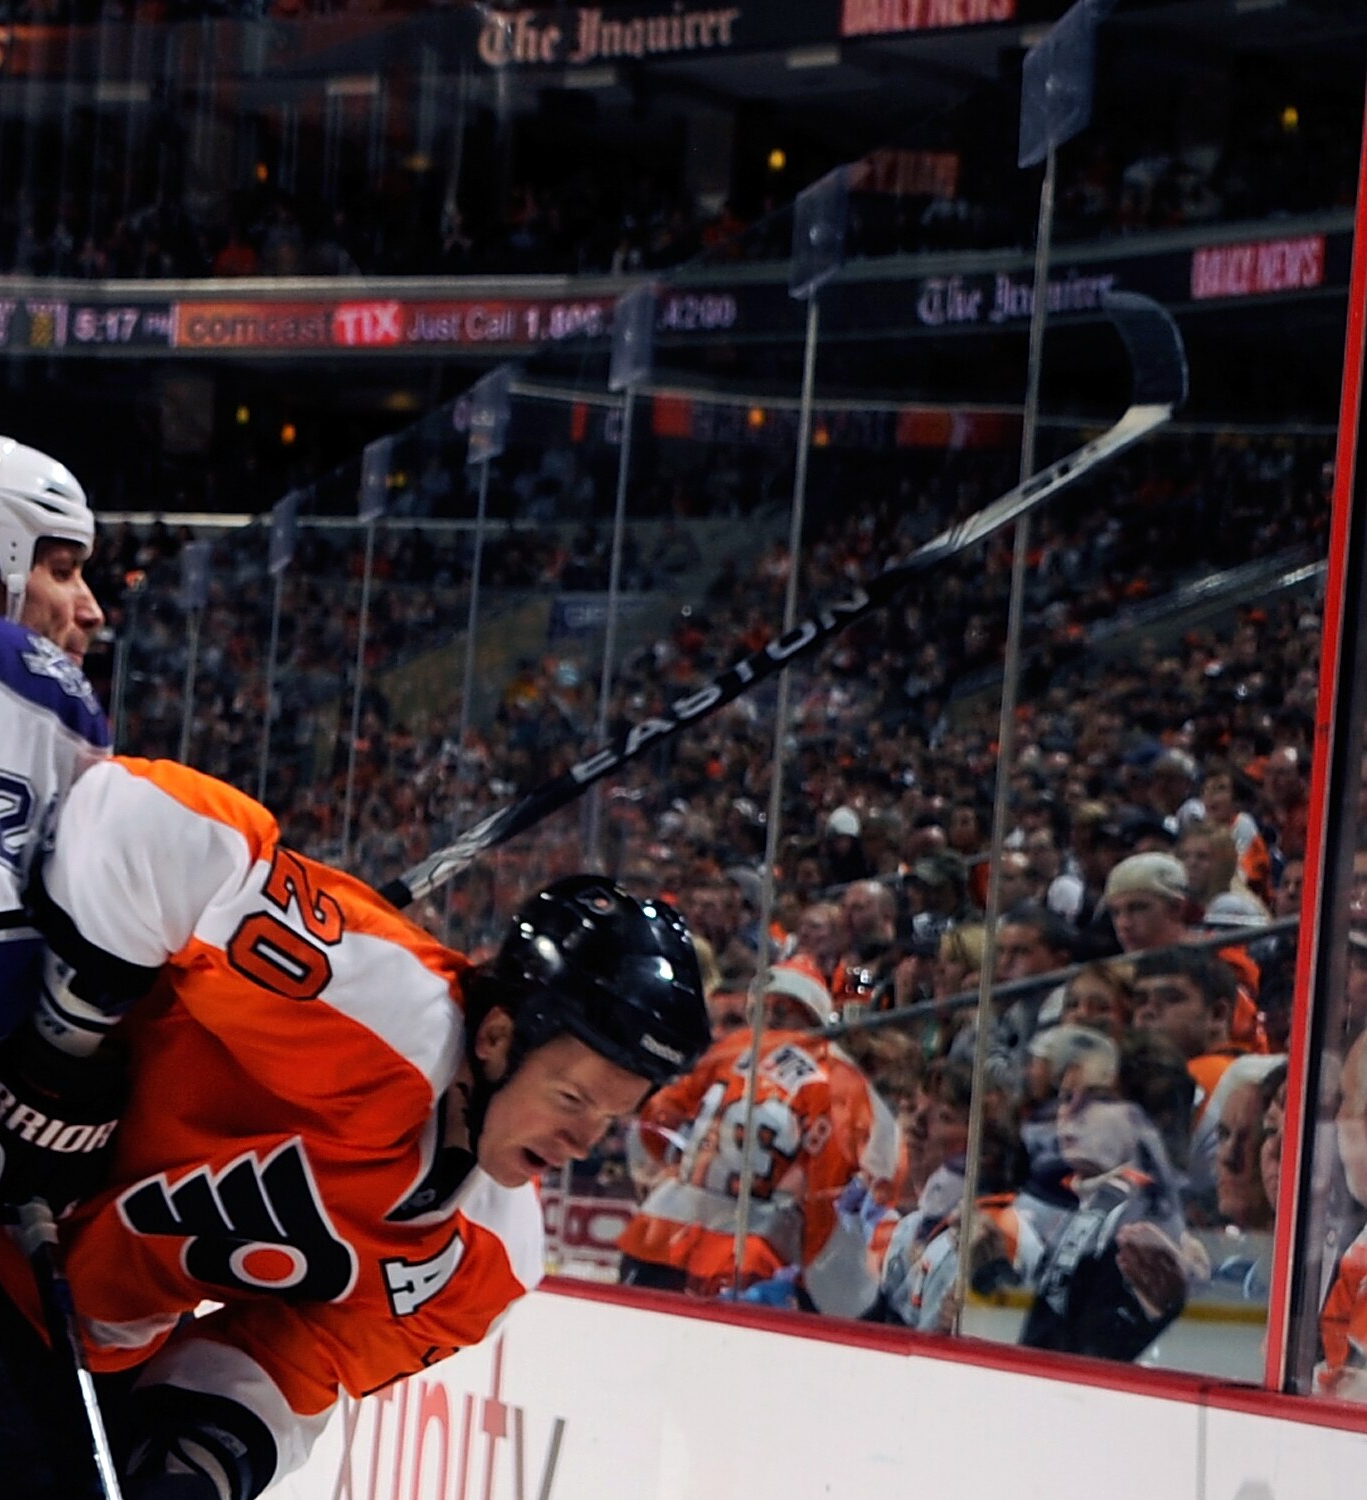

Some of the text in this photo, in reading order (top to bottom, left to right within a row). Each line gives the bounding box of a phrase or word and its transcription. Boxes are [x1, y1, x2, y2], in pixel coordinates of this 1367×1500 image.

[477, 4, 739, 65] The Inquirer
[336, 303, 399, 345] TIX
[407, 311, 460, 343] Just
[467, 306, 515, 341] Call
[989, 271, 1114, 322] Inuirer
[226, 845, 346, 1002] 20
[380, 1229, 465, 1317] A
